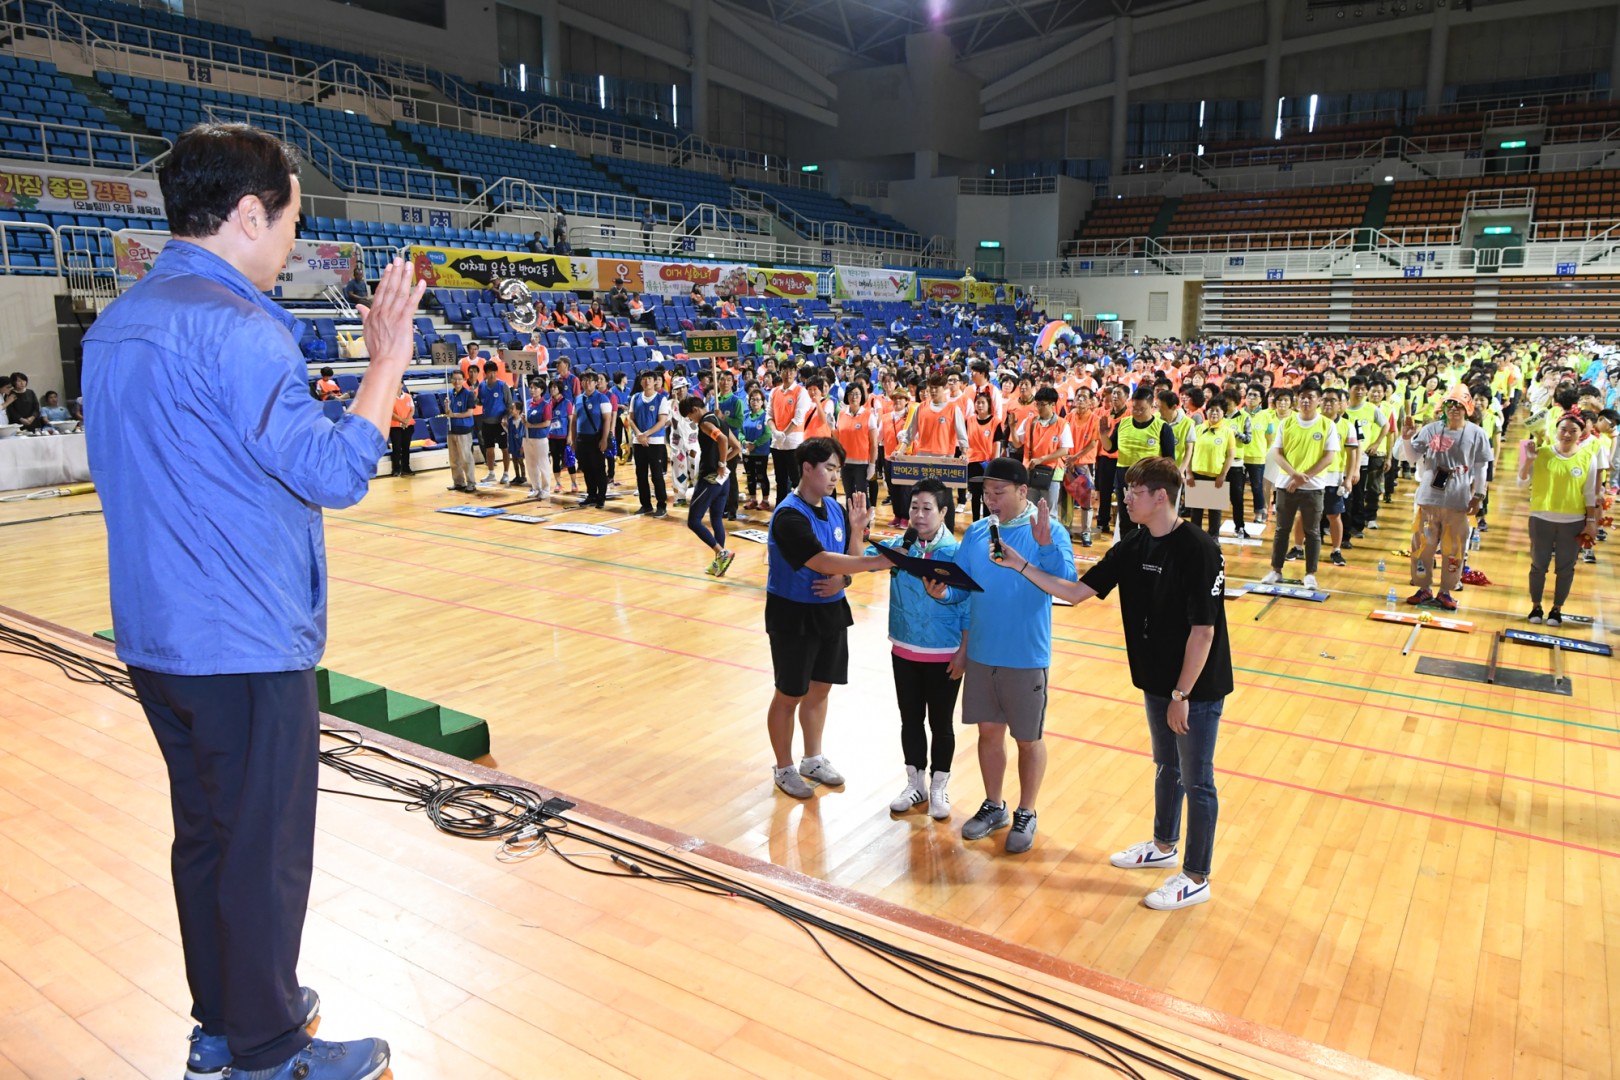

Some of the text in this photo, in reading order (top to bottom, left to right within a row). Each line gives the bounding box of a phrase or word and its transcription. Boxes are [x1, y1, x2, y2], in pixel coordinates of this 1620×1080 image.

[0, 173, 43, 197] 가장
[47, 176, 90, 201] 좋은
[91, 180, 132, 204] 경품
[112, 203, 135, 214] 우1동
[432, 217, 449, 228] 2-3
[684, 242, 694, 250] 2-4
[459, 259, 487, 272] 어차피
[518, 263, 548, 278] 반여2동
[665, 268, 683, 278] 이거
[1558, 266, 1575, 274] 1-10
[772, 277, 784, 287] 이거
[692, 337, 731, 352] 반송1동
[435, 352, 454, 363] 우3동
[893, 466, 965, 479] 반여2동 행정복지센터
